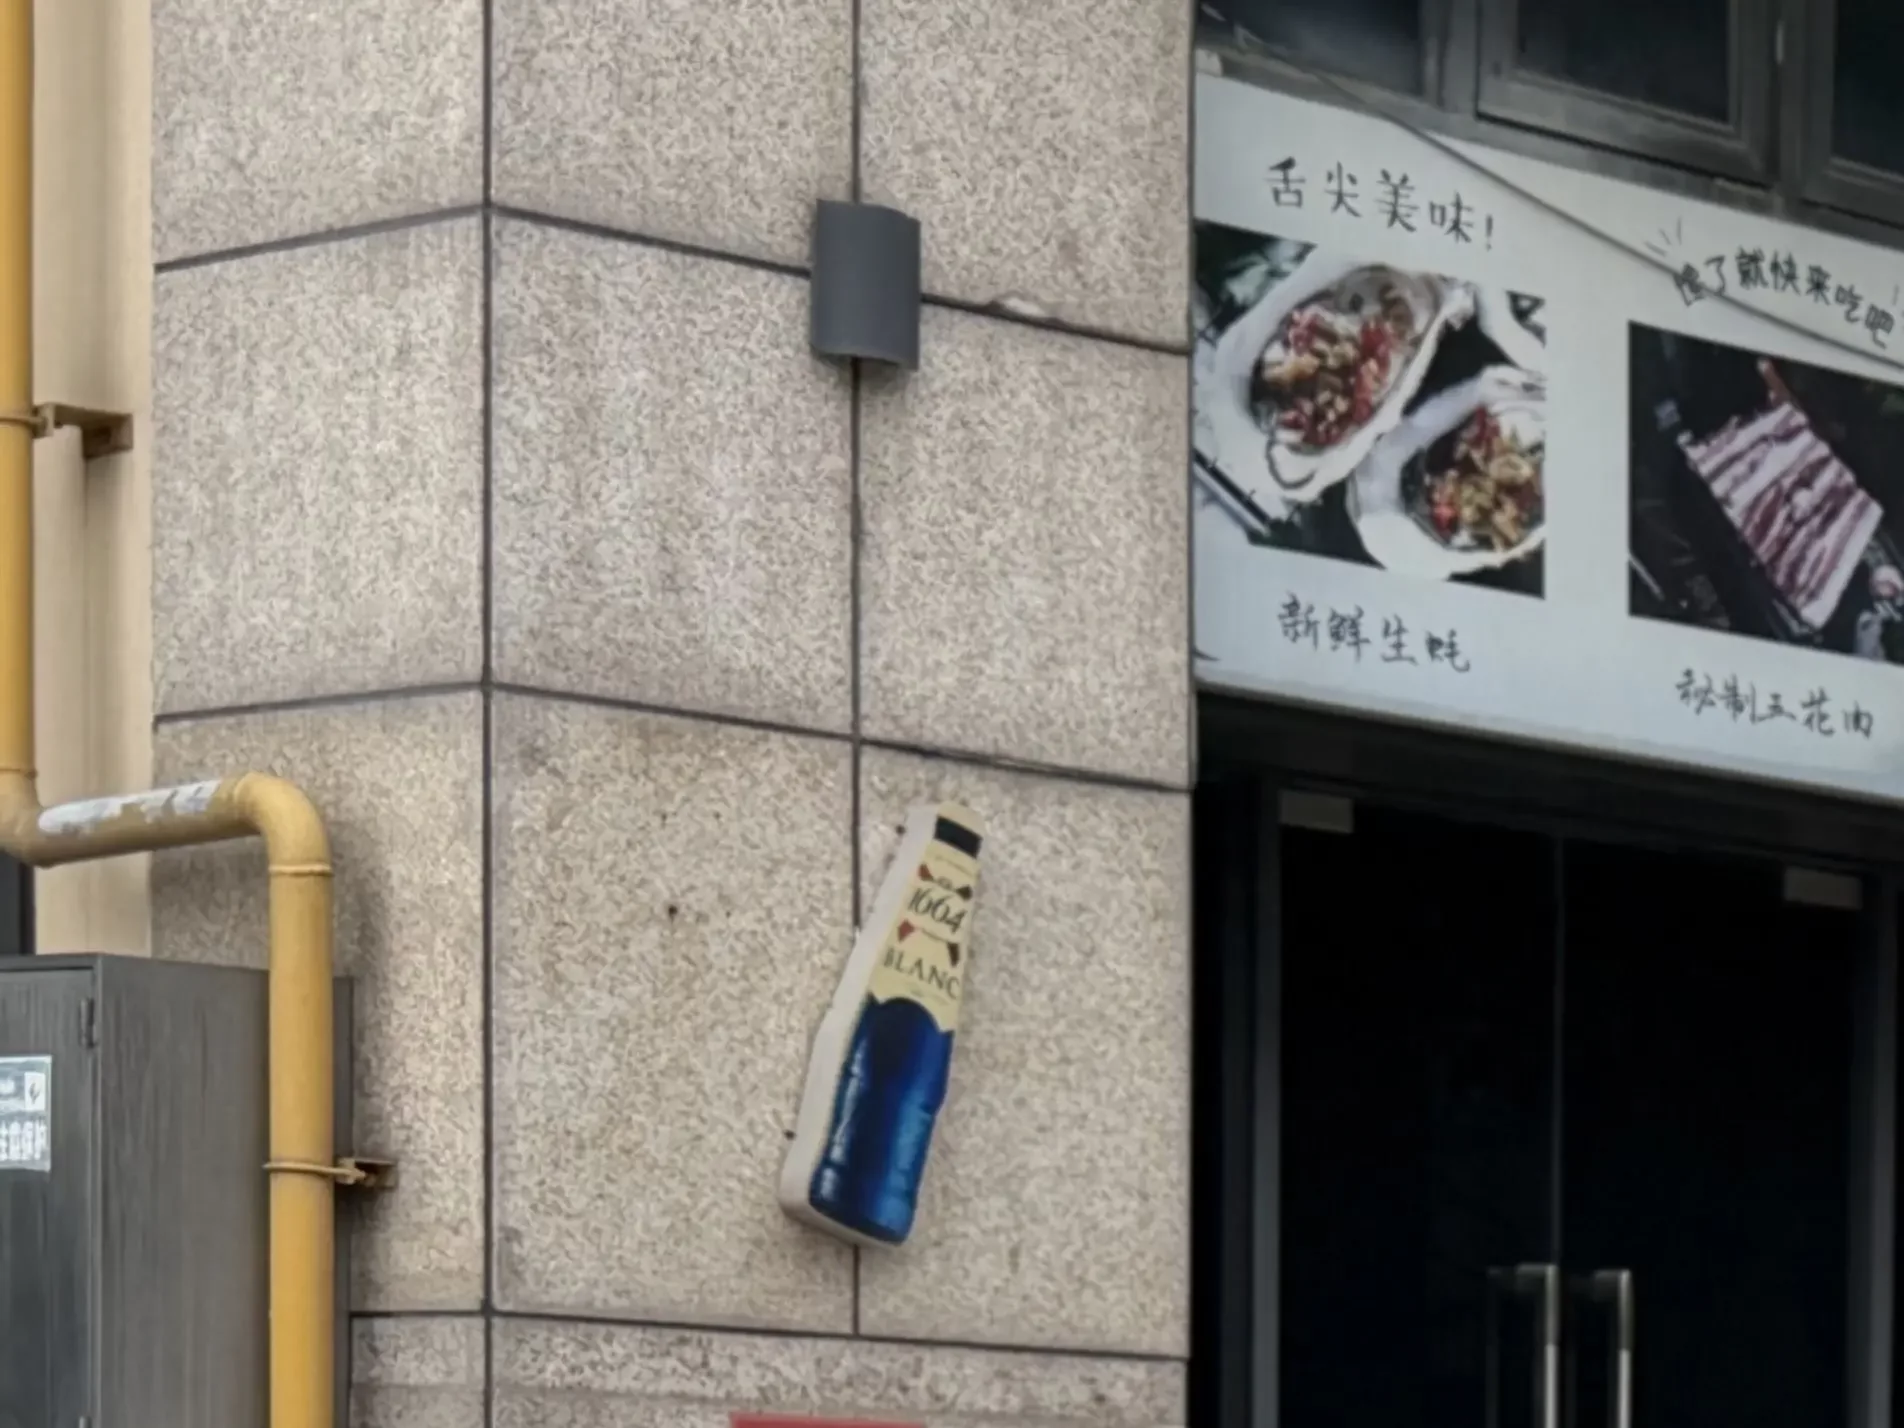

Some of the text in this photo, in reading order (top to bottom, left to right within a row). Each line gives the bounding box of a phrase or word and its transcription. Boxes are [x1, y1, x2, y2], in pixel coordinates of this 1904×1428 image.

[1264, 156, 1494, 252] 舌尖美味!
[1278, 591, 1470, 673] 新鲜生蚝
[1675, 668, 1874, 738] 秘制五花肉
[907, 888, 968, 934] 1664
[883, 947, 960, 999] BLANC
